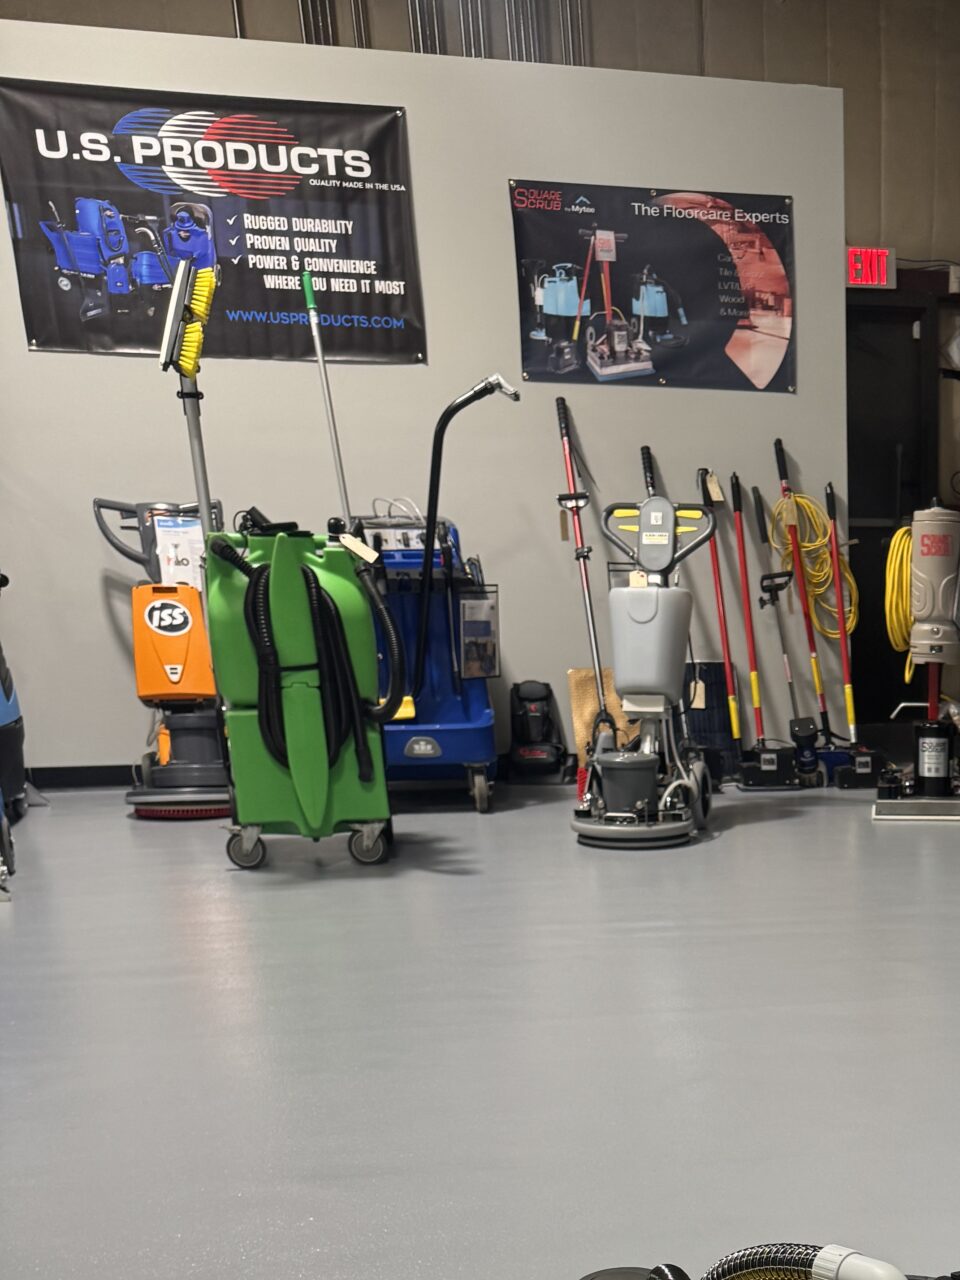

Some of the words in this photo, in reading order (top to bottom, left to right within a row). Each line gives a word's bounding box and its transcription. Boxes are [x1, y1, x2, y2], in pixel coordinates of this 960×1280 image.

[35, 129, 121, 162] U.S.
[131, 135, 372, 178] PRODUCTS
[309, 178, 341, 187] QUALITY
[342, 181, 364, 189] MADE
[514, 199, 561, 210] SCRUB
[631, 202, 660, 217] The
[664, 204, 731, 221] Floorcare
[734, 209, 789, 225] Experts
[243, 213, 288, 231] RUGGED
[292, 217, 353, 234] DURABILITY
[245, 233, 290, 251] PROVEN
[293, 237, 337, 253] QUALITY
[248, 254, 287, 270] POWER
[291, 257, 300, 271] &
[304, 257, 377, 275] CONVENIENCE
[848, 248, 889, 286] EXIT
[263, 275, 301, 290] WHERE
[310, 277, 327, 291] OU
[331, 278, 357, 293] NEED
[361, 279, 371, 294] IT
[374, 280, 406, 295] MOST
[226, 310, 405, 329] WWW.USPRDUCTS.COM
